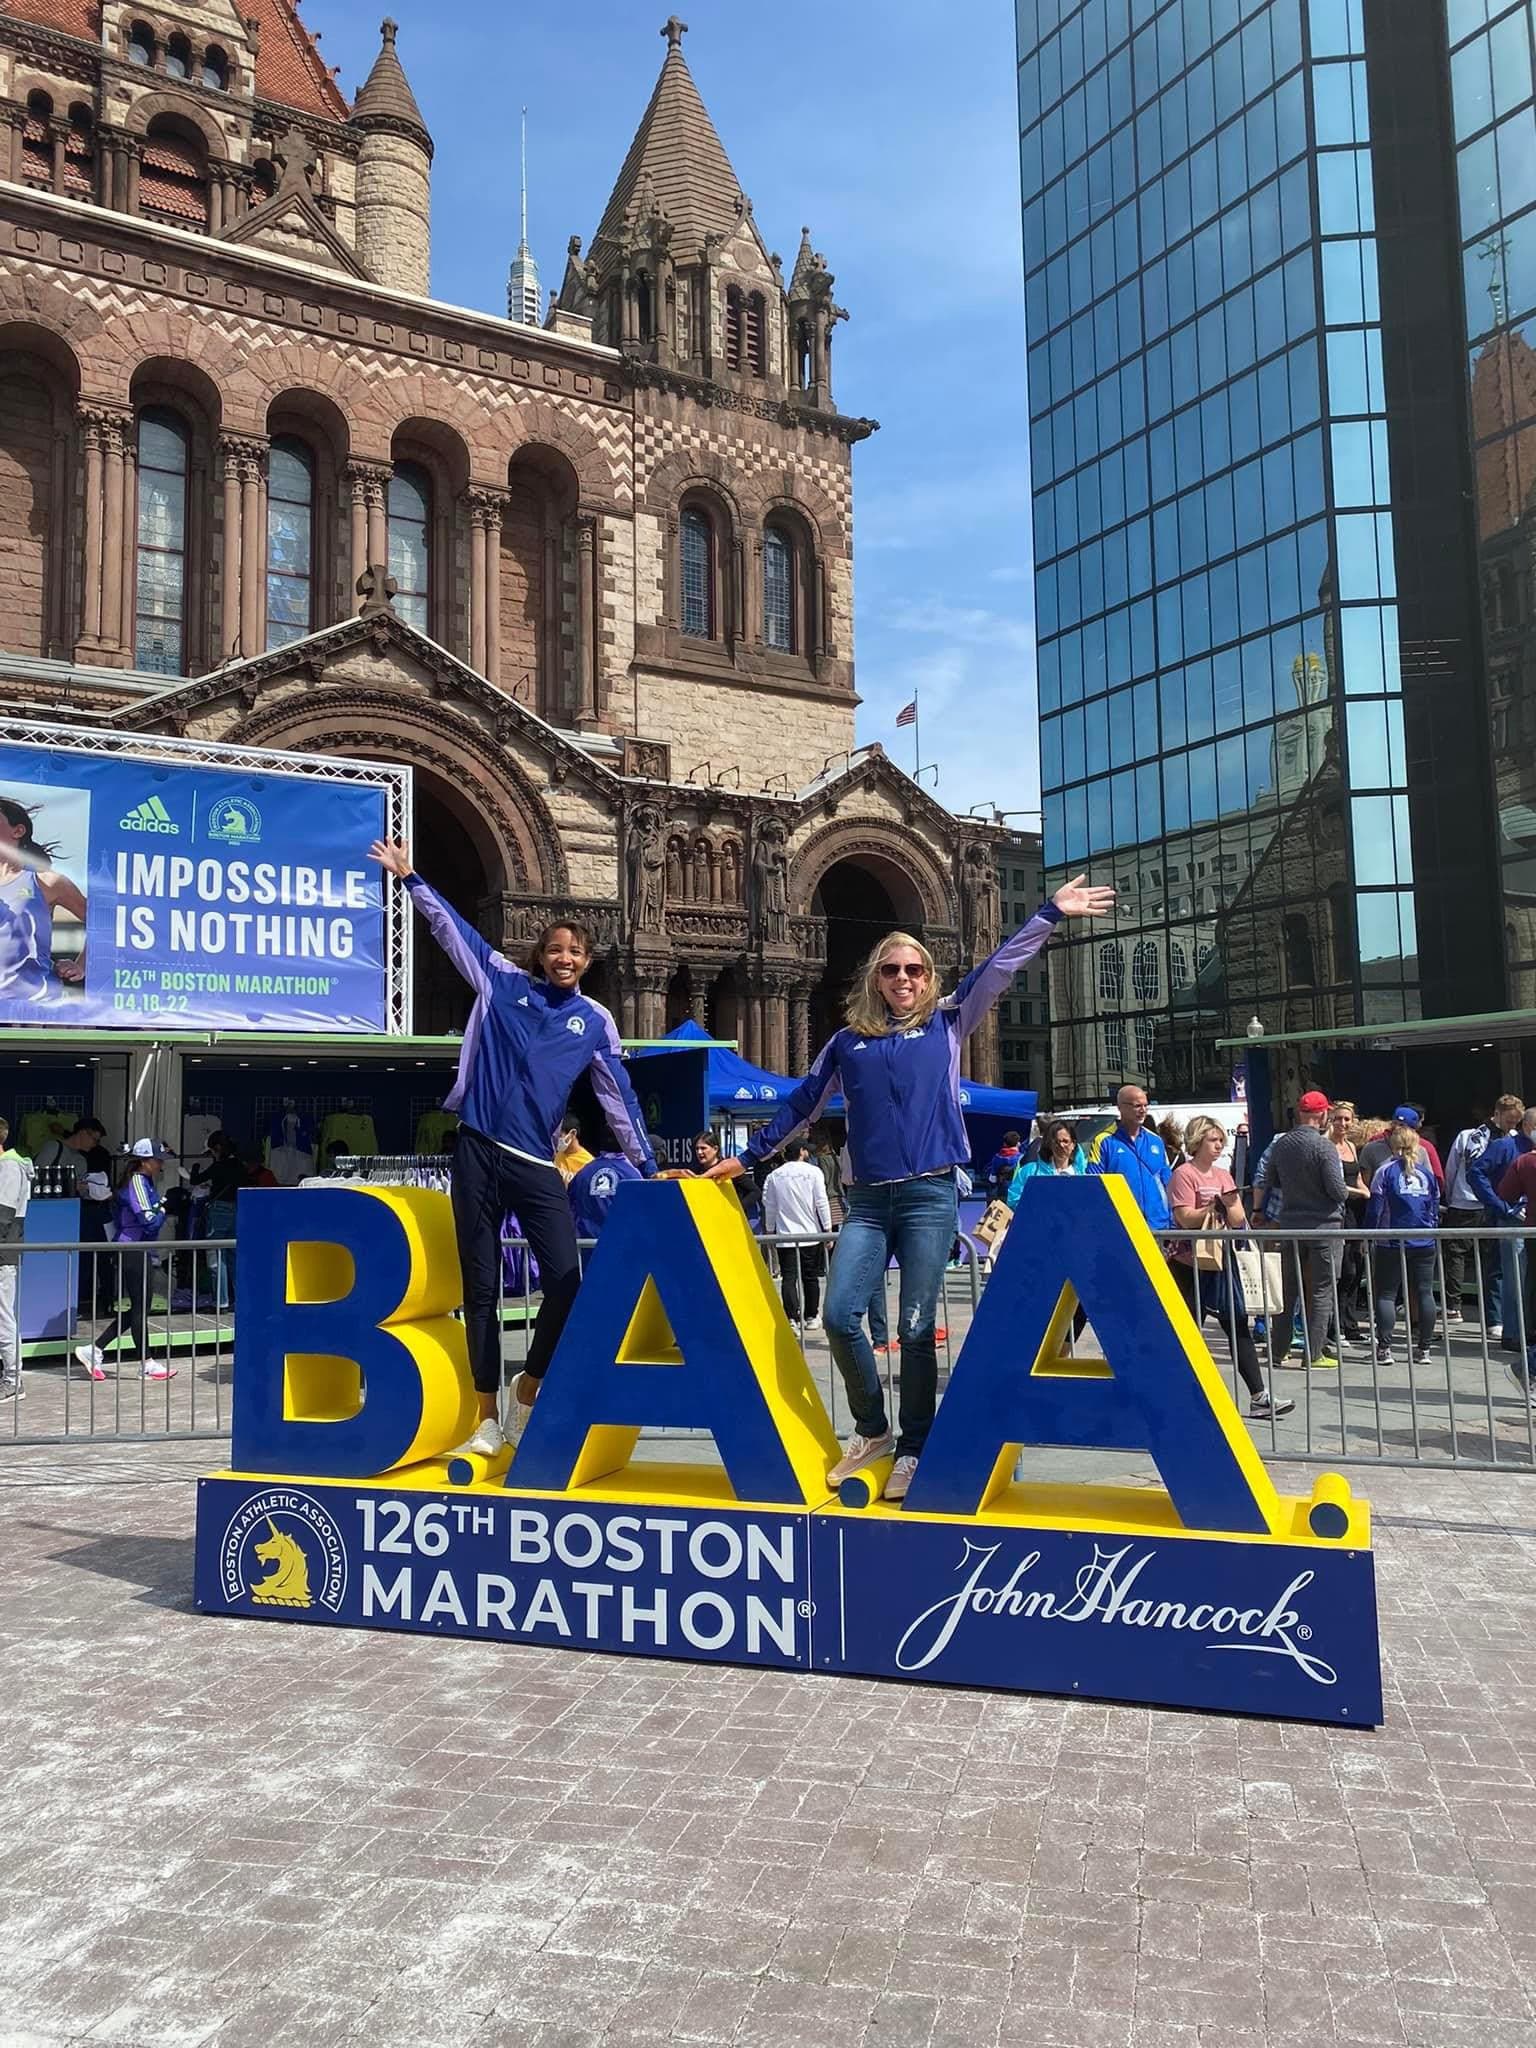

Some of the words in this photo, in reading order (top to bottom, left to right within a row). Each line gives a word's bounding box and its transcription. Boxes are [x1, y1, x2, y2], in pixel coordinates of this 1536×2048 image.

[119, 817, 180, 835] adidas
[116, 852, 367, 908] IMPOSSIBLE
[115, 905, 155, 949] IS
[170, 909, 353, 959] NOTHING
[114, 969, 156, 989] 126TH
[160, 971, 230, 993] BOSTON
[114, 993, 189, 1012] 04.18.22
[682, 1138, 693, 1163] IS
[225, 1526, 244, 1594] BOSTON
[240, 1495, 298, 1528] ATHLETIC
[299, 1502, 342, 1604] ASSOCIATION
[356, 1499, 494, 1557] 126TH
[510, 1510, 795, 1583] BOSTON
[895, 1537, 1057, 1671] John
